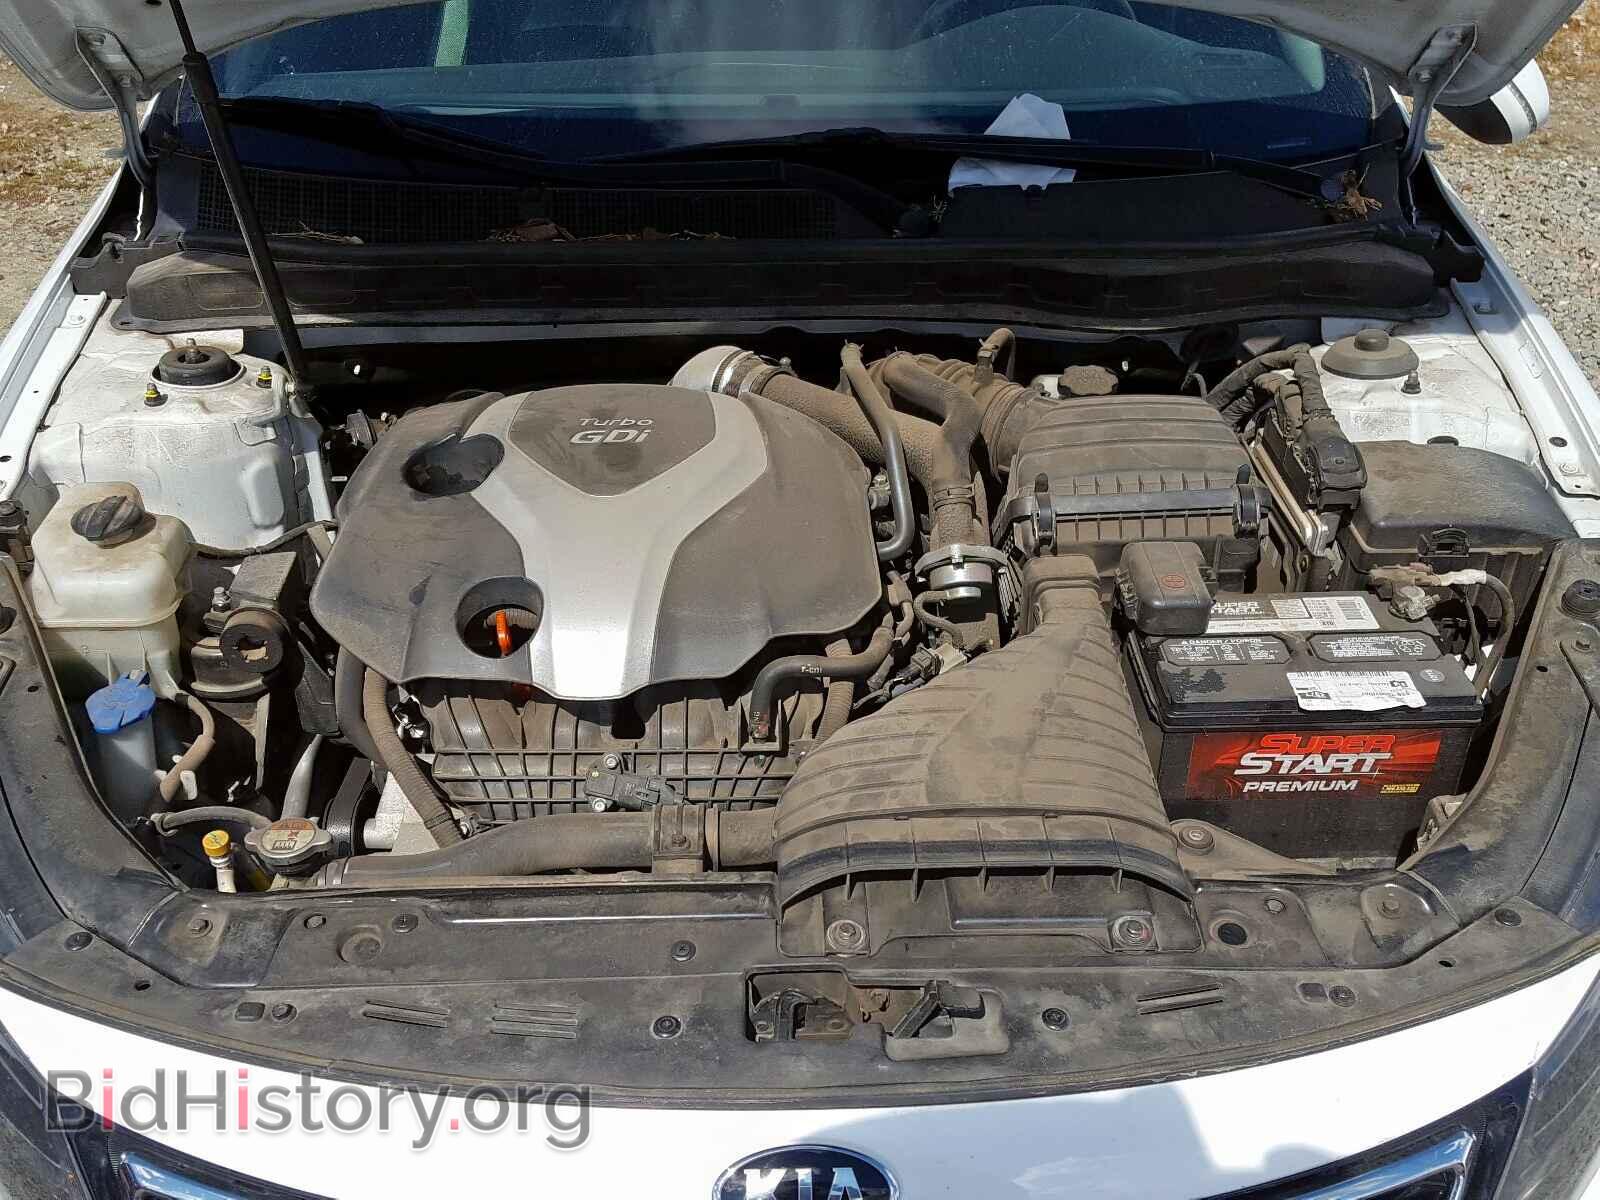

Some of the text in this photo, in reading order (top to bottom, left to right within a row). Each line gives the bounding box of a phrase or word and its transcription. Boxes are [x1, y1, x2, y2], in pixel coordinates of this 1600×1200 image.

[580, 416, 653, 426] Turbo
[570, 429, 652, 444] GDi
[1258, 733, 1396, 754] SUPER
[1234, 752, 1393, 775] START
[1243, 779, 1360, 793] PREMIUM
[744, 1167, 864, 1200] KIA
